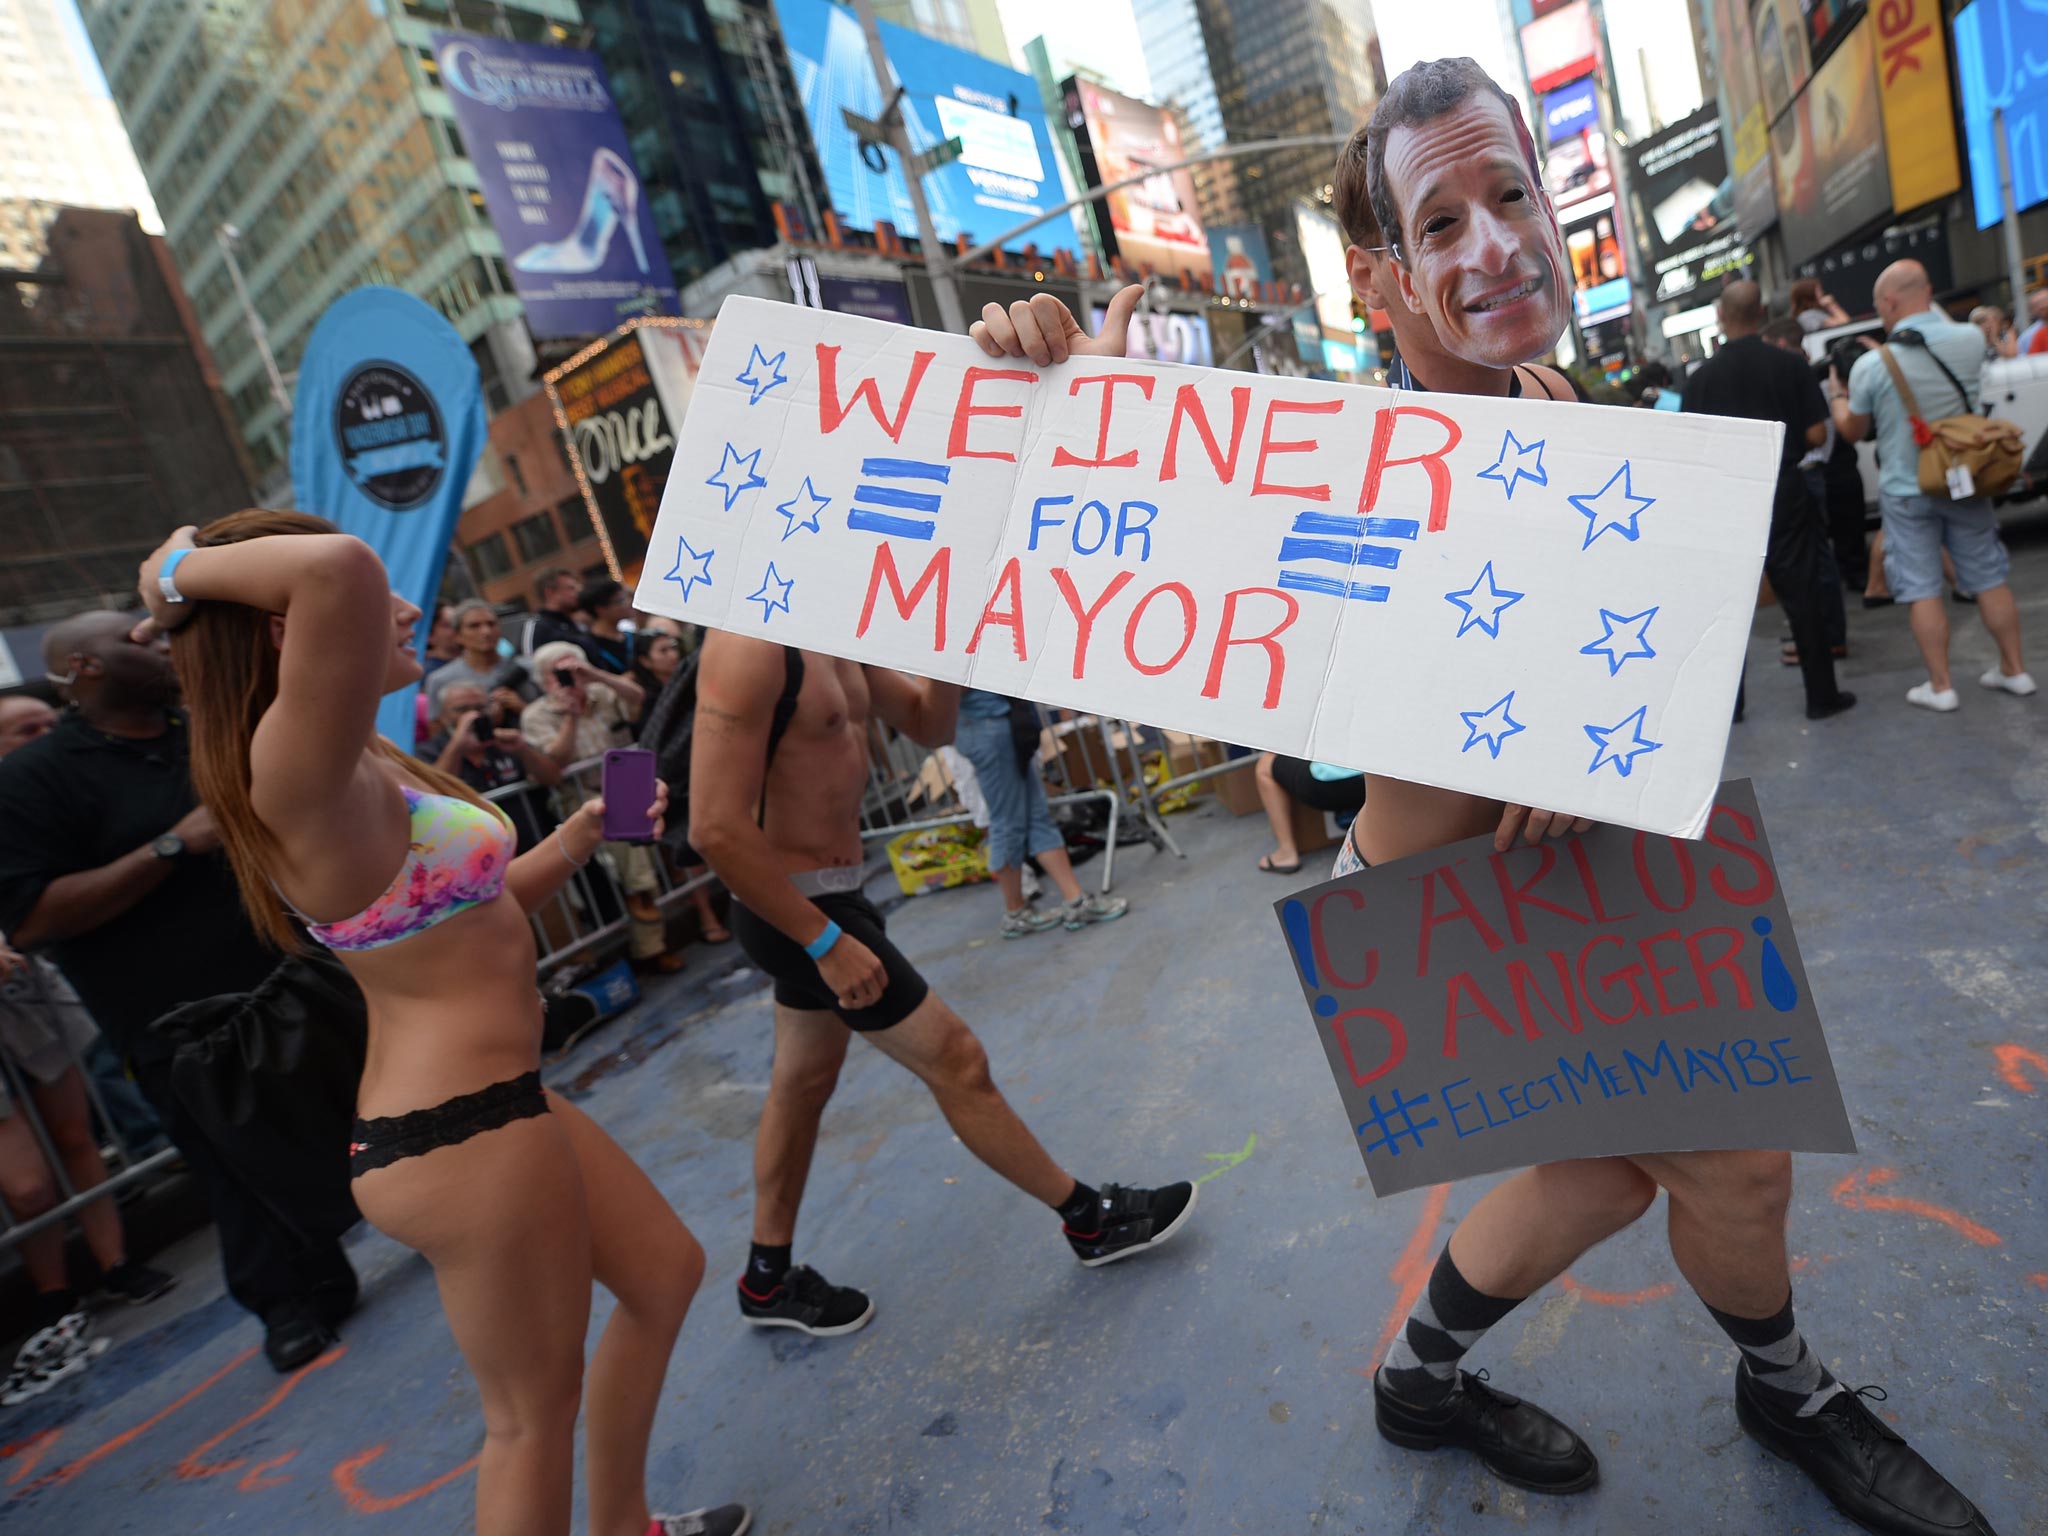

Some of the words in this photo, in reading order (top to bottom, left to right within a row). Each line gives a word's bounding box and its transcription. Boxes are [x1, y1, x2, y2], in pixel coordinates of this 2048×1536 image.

[816, 343, 1462, 532] WEINER
[1028, 496, 1158, 562] FOR
[856, 541, 1299, 709] MAYOR
